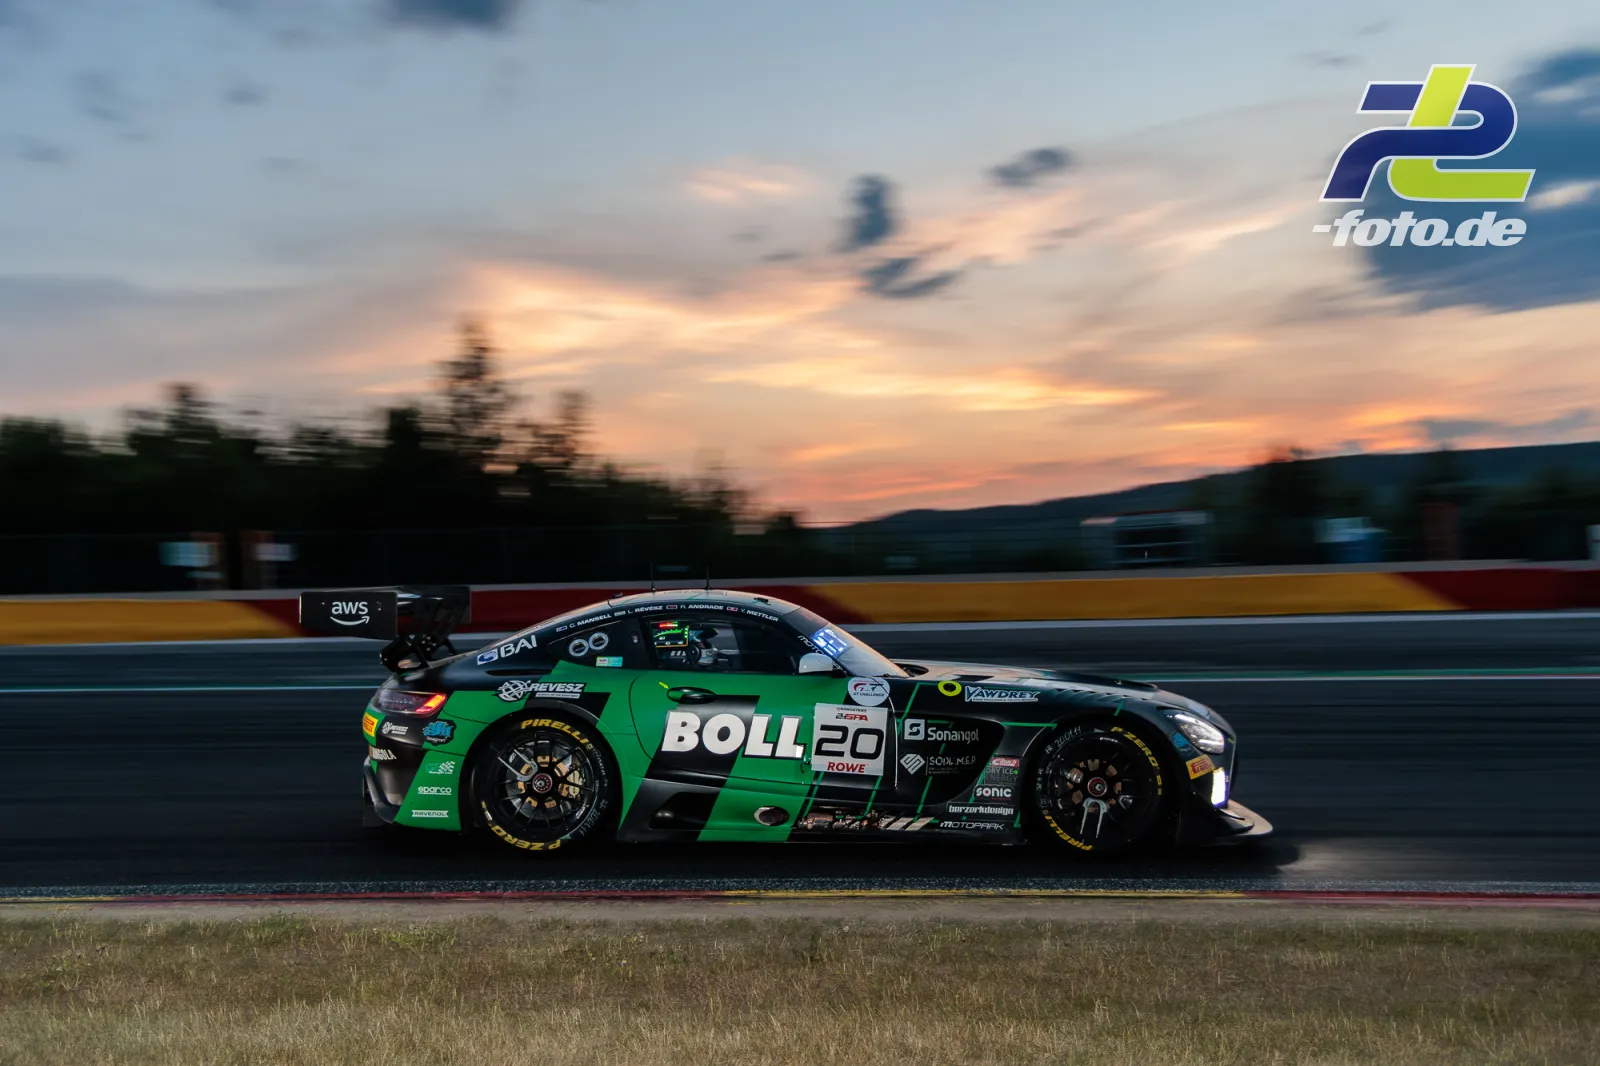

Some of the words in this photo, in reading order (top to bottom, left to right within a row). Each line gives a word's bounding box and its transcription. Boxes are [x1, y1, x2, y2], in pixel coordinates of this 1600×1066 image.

[331, 601, 369, 615] aws
[577, 613, 612, 627] MANSELL
[746, 609, 779, 623] METTLER
[500, 634, 538, 658] BAI
[530, 682, 585, 693] REVESZ
[966, 686, 1041, 702] VAWDREY
[521, 718, 590, 744] PIRELLI
[661, 711, 805, 758] BOLL
[928, 727, 979, 745] Sonangol
[814, 724, 885, 760] 20
[1123, 731, 1159, 768] ZERO
[826, 761, 866, 774] ROWE
[986, 773, 1018, 783] ENERGY
[417, 786, 452, 794] sparco
[948, 805, 1014, 816] berzerkdesign
[939, 820, 1004, 830] MOTOPARK
[491, 825, 545, 851] ZERO
[1044, 815, 1093, 851] PIRELLI
[548, 838, 561, 851] P
